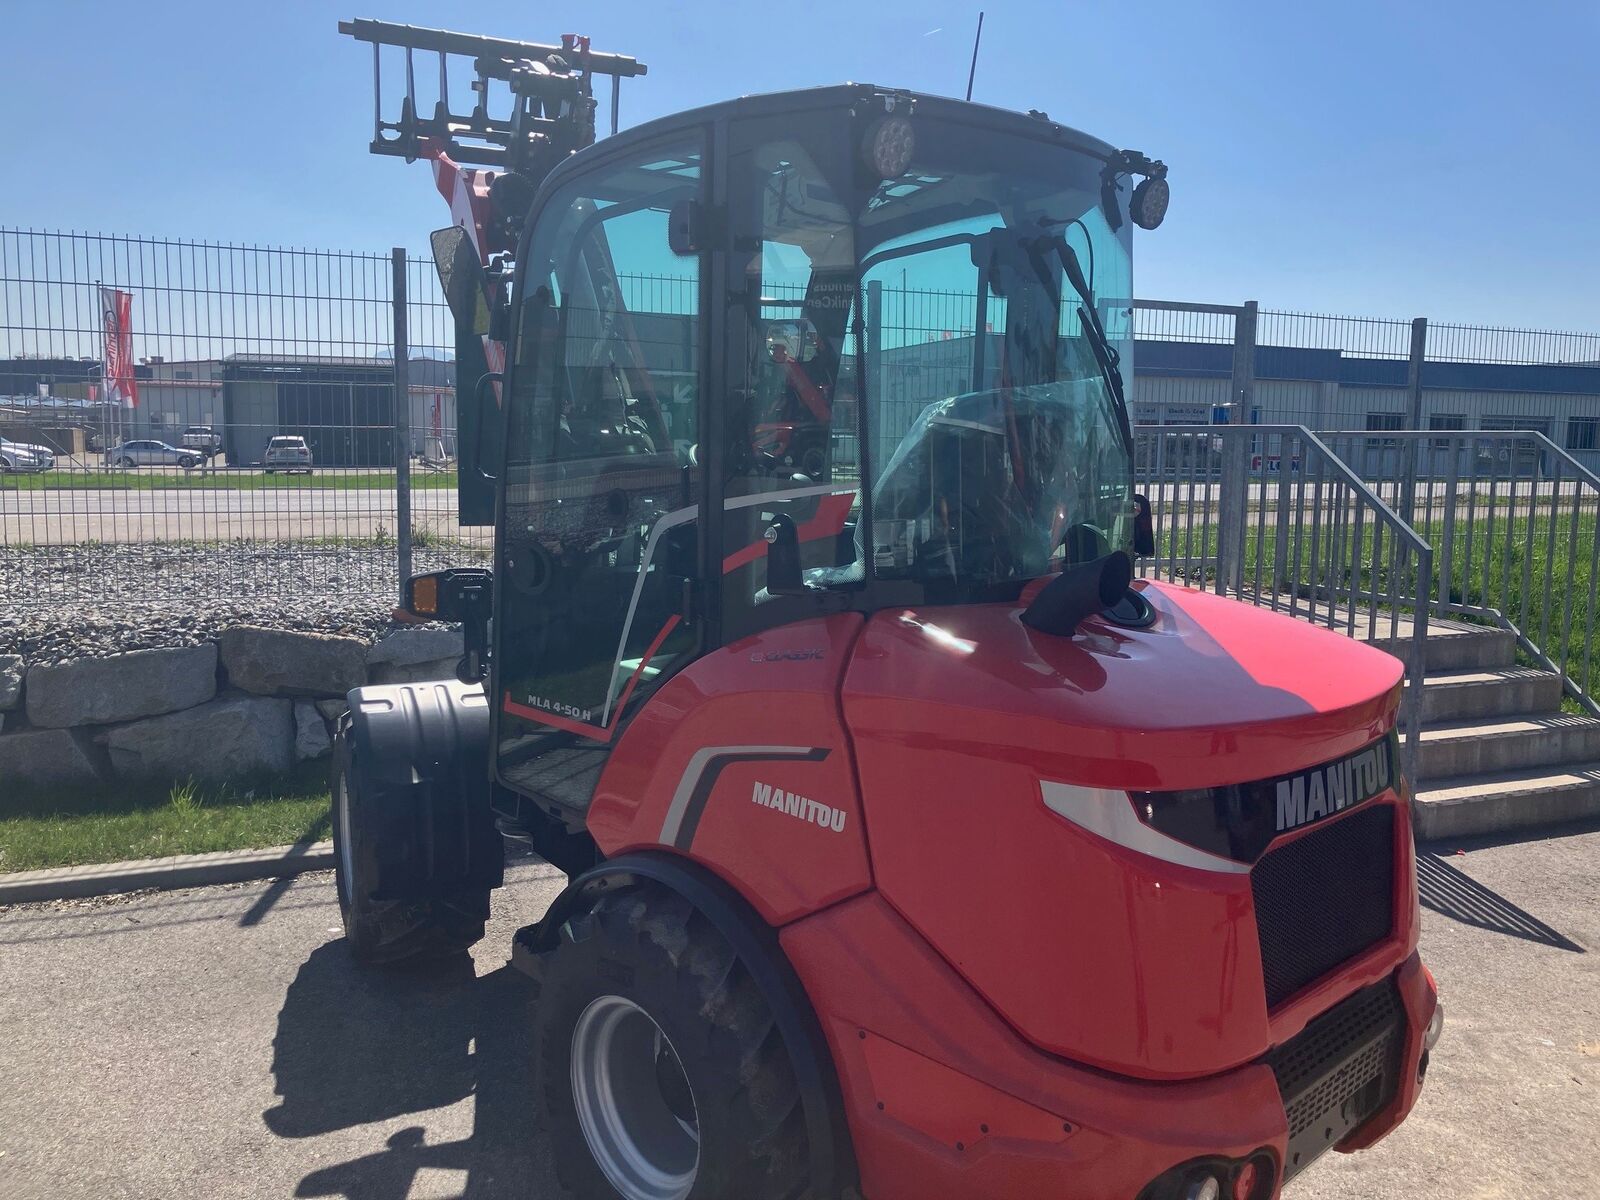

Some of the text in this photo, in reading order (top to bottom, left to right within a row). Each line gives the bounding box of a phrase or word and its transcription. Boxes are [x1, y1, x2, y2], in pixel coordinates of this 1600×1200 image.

[528, 695, 591, 721] MLA 4-50 H
[751, 781, 847, 833] MANITOU
[1276, 741, 1389, 831] MANITOU
